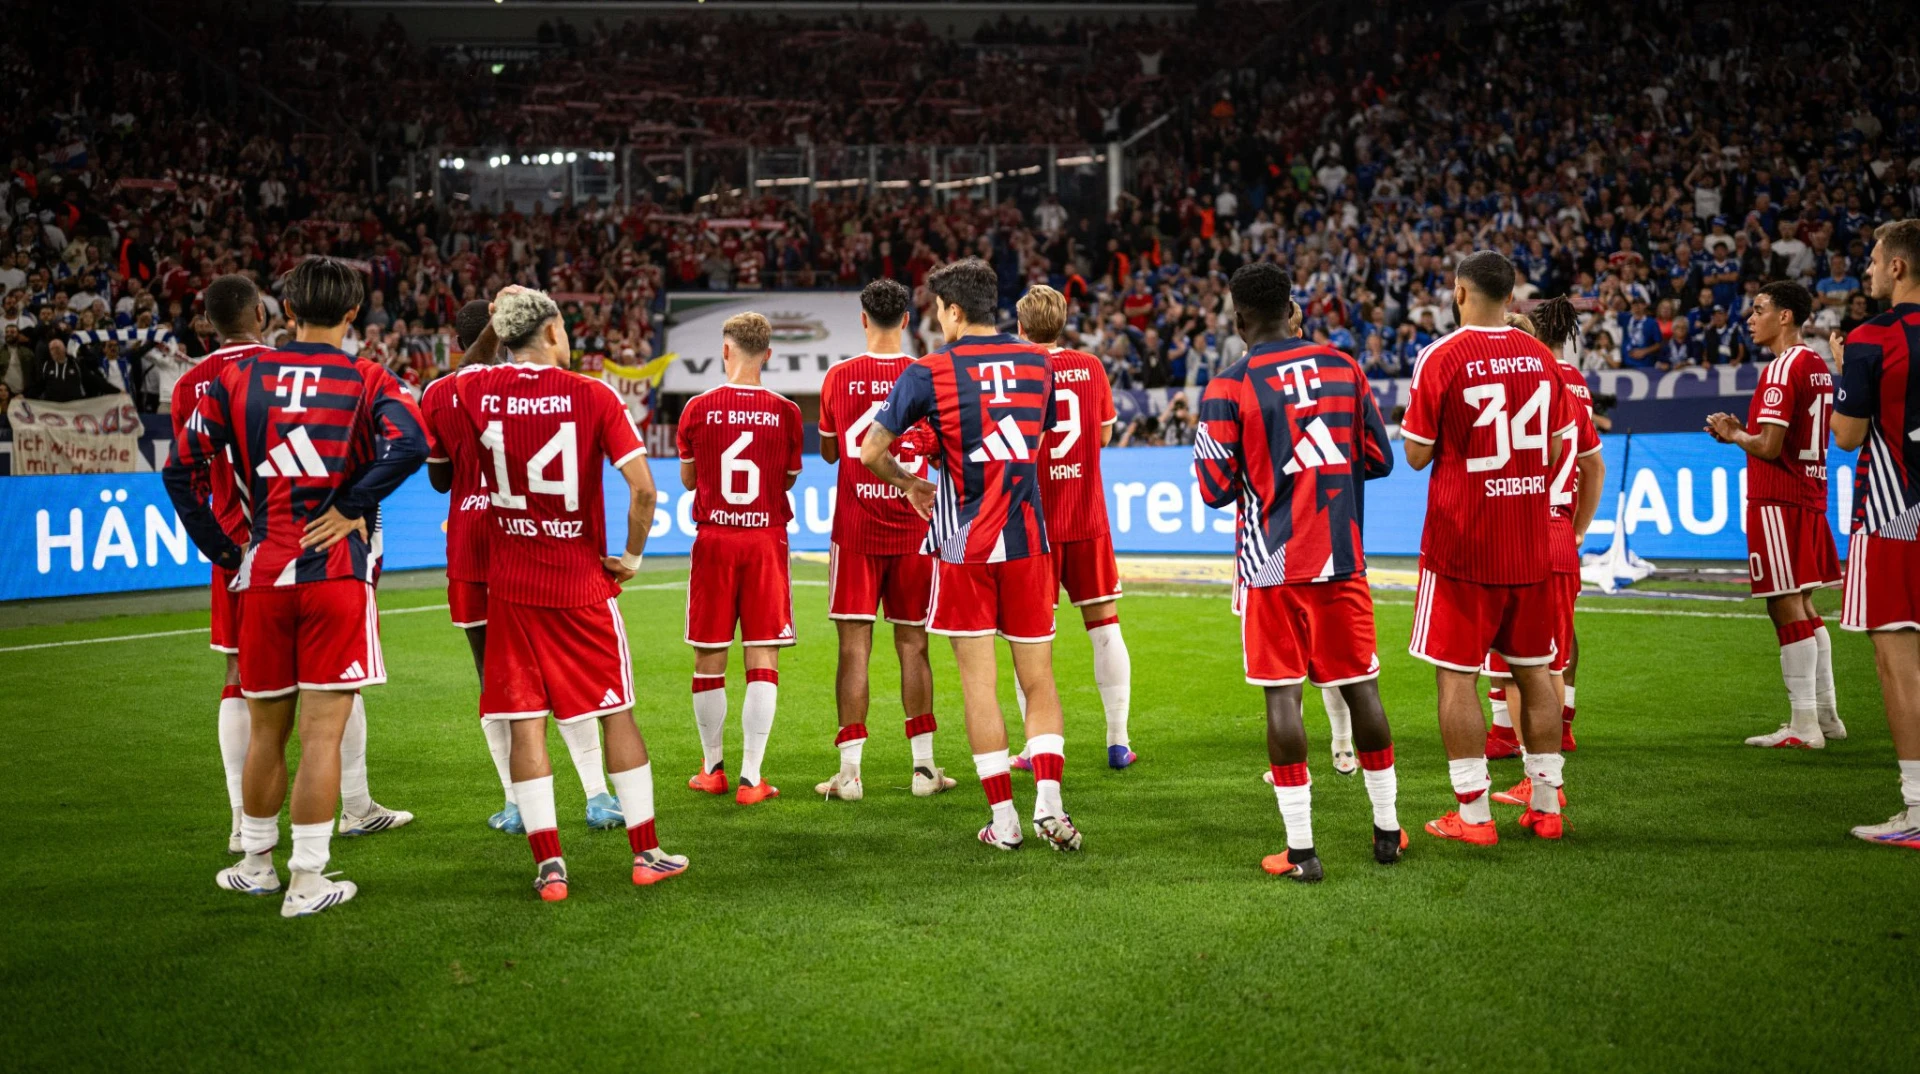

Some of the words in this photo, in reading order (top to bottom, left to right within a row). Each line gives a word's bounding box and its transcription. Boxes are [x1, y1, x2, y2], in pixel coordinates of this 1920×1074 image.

[1466, 360, 1486, 378] FC
[1490, 357, 1543, 375] BAYERN
[849, 381, 865, 395] FC
[481, 395, 501, 413] FC
[507, 395, 571, 415] BAYERN
[1760, 408, 1782, 416] Allianz
[706, 411, 723, 425] FC
[728, 410, 780, 427] BAYERN
[1050, 388, 1082, 460] 9
[1462, 380, 1551, 473] 34
[17, 434, 44, 452] ich
[26, 456, 59, 474] mir
[480, 420, 579, 513] 14
[720, 431, 761, 505] 6
[1050, 463, 1082, 481] KANE
[1485, 475, 1546, 497] SAIBARI
[541, 517, 584, 539] DÍAZ
[709, 508, 770, 528] KIMMICH
[36, 488, 211, 574] HÄN
